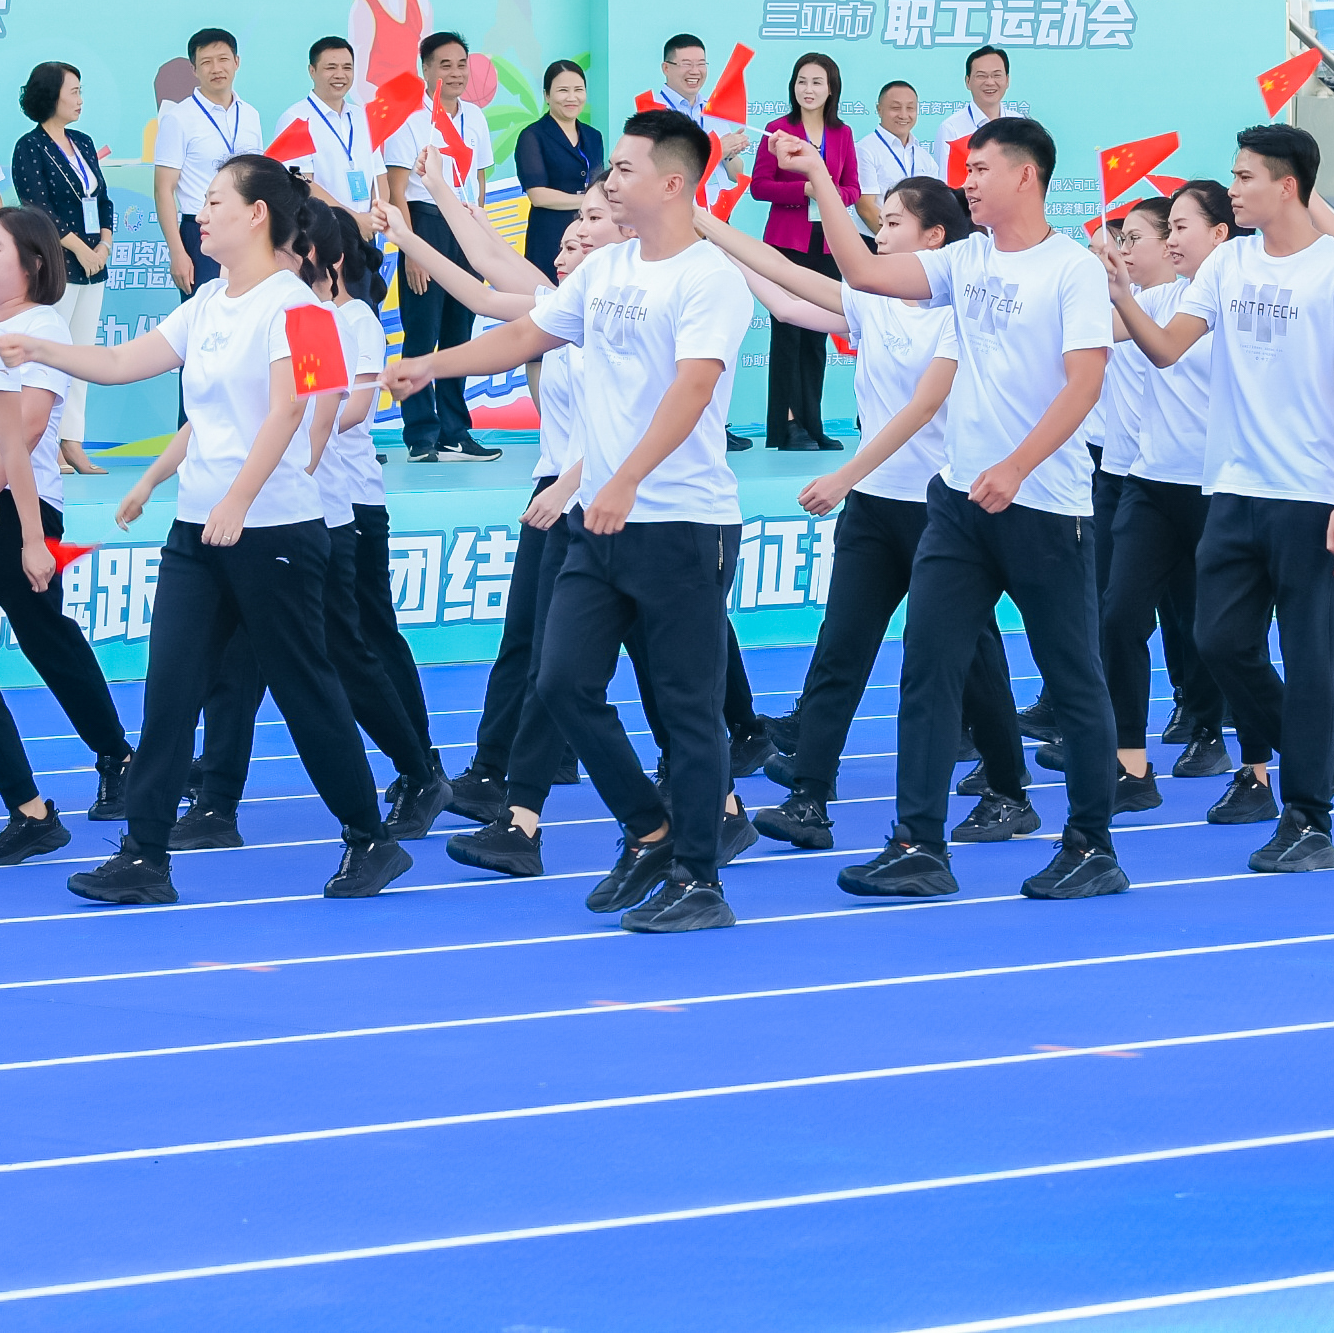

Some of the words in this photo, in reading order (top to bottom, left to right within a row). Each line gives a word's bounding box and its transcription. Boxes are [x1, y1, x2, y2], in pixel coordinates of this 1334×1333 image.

[762, 1, 873, 40] 三亚市
[884, 0, 1136, 47] 职工运动会
